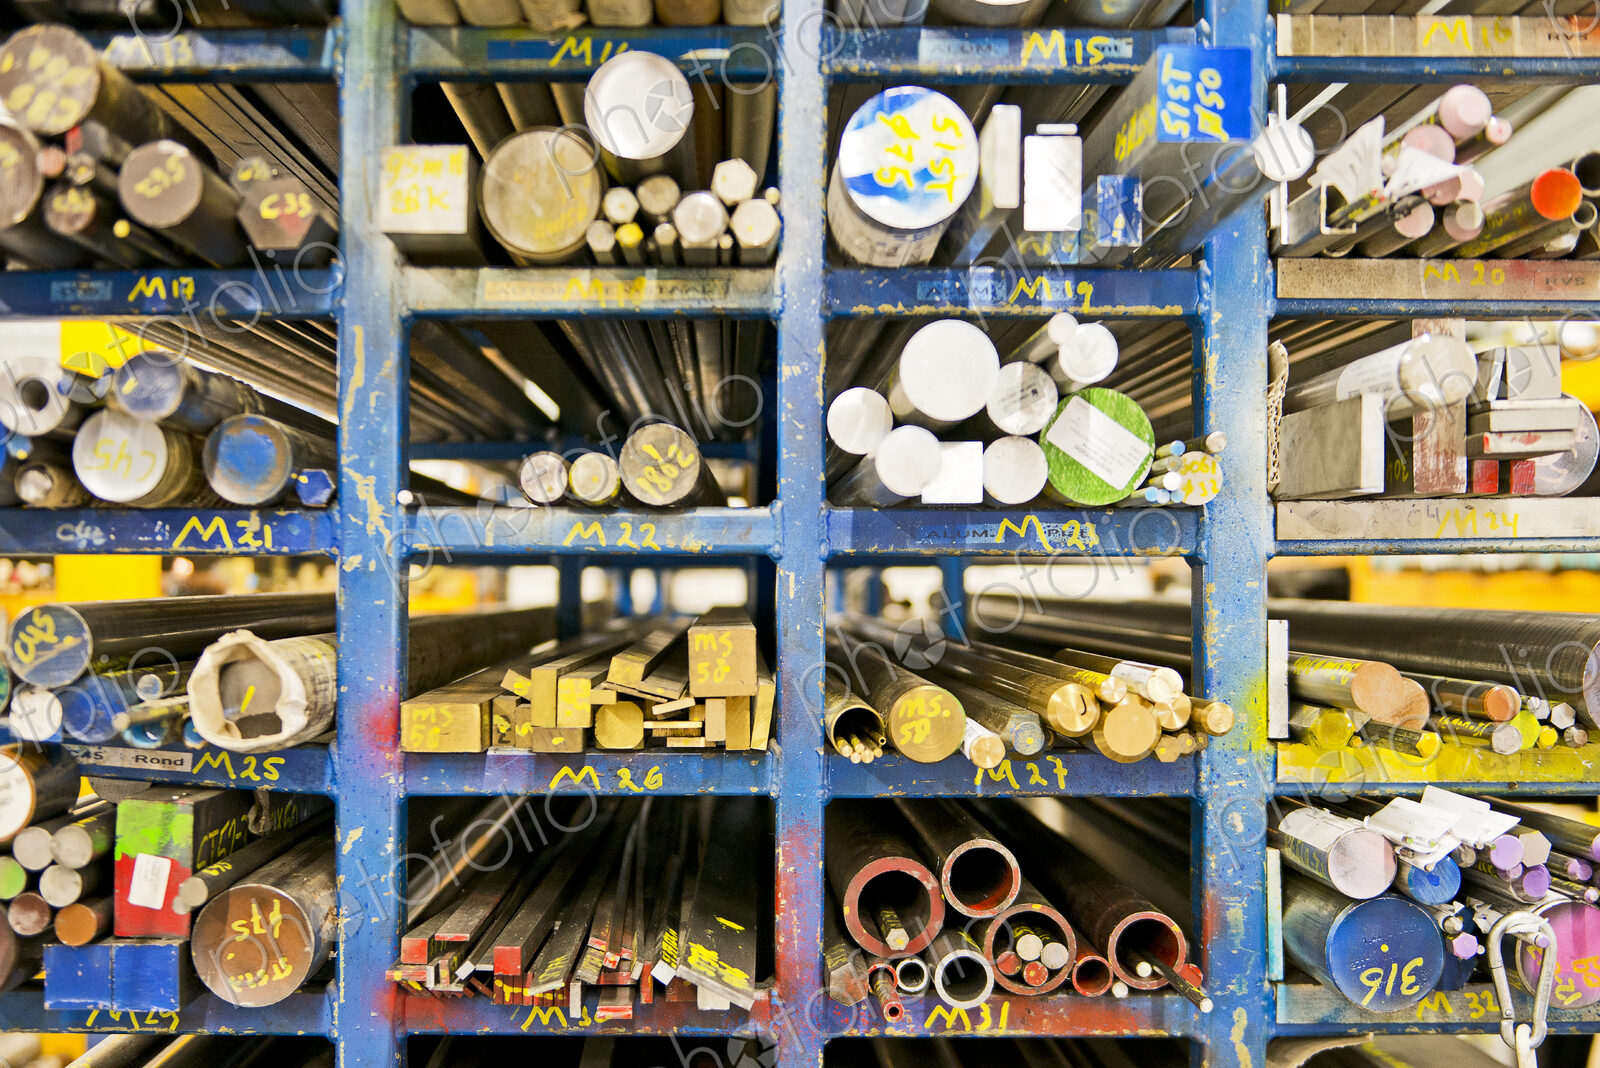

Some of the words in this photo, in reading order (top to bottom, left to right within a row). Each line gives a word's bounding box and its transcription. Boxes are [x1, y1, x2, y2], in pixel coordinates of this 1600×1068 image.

[549, 36, 629, 67] M1
[1021, 30, 1110, 66] M15
[259, 192, 313, 219] C35
[127, 275, 196, 302] M17
[1423, 262, 1505, 287] M20
[1545, 275, 1586, 287] RVS
[1009, 276, 1094, 313] M19
[172, 515, 274, 549] M21
[562, 520, 662, 551] M22
[134, 754, 185, 767] Rond
[191, 751, 286, 782] M25
[974, 755, 1069, 790] M27
[548, 765, 664, 794] M26
[925, 1002, 1010, 1032] M31
